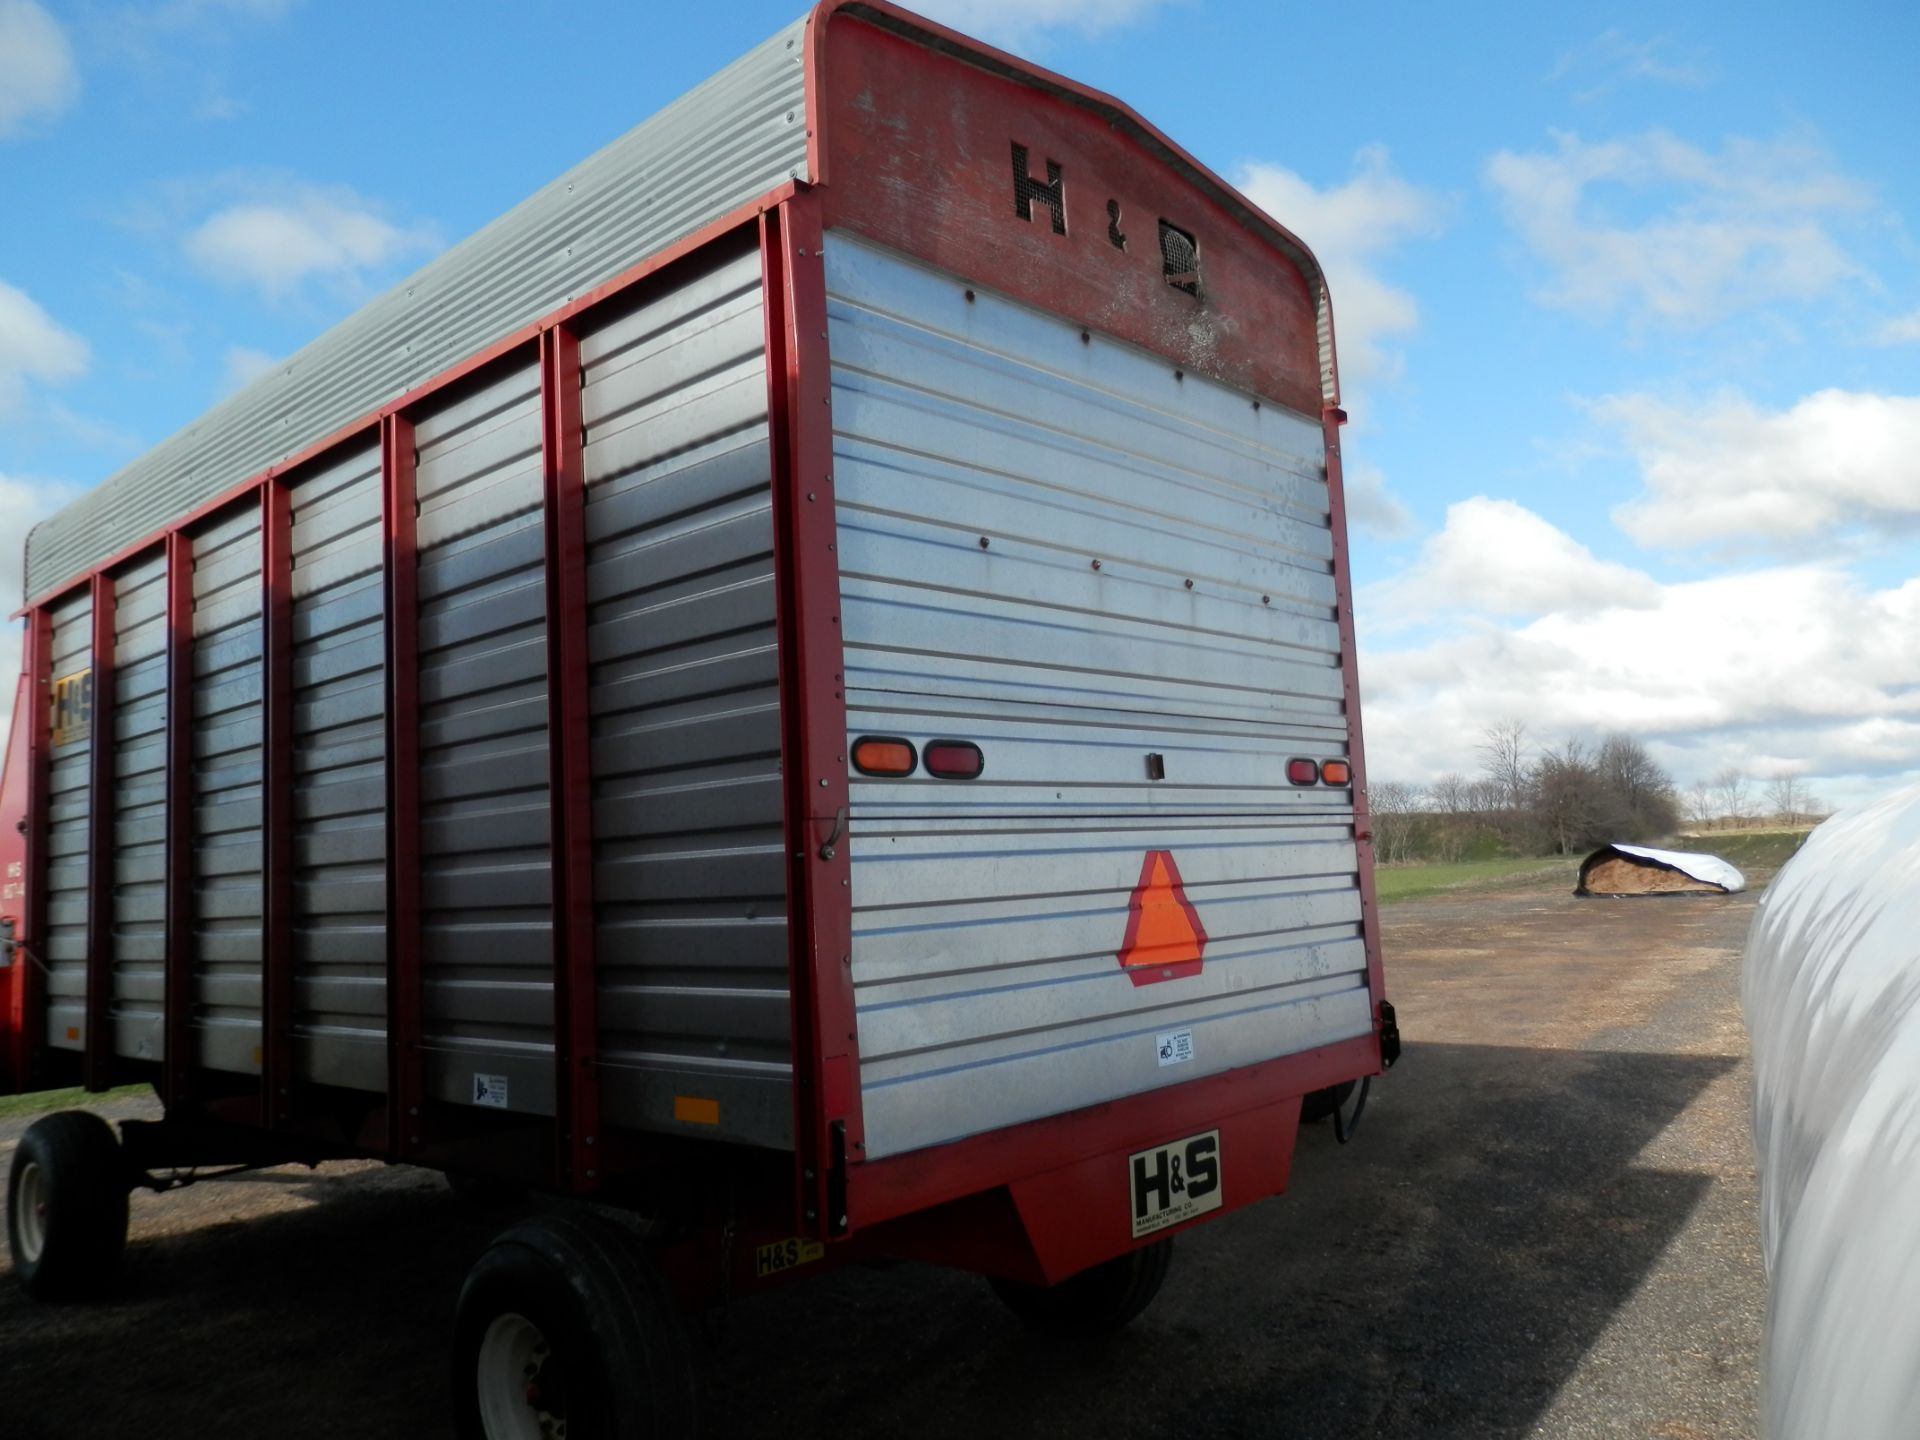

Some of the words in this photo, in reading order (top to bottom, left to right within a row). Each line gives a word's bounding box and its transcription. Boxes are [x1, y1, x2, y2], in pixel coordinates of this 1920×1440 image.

[1011, 141, 1067, 237] H
[1134, 1136, 1218, 1218] H&S
[1136, 1205, 1182, 1226] MANUFACTURING
[759, 1241, 799, 1274] H&S
